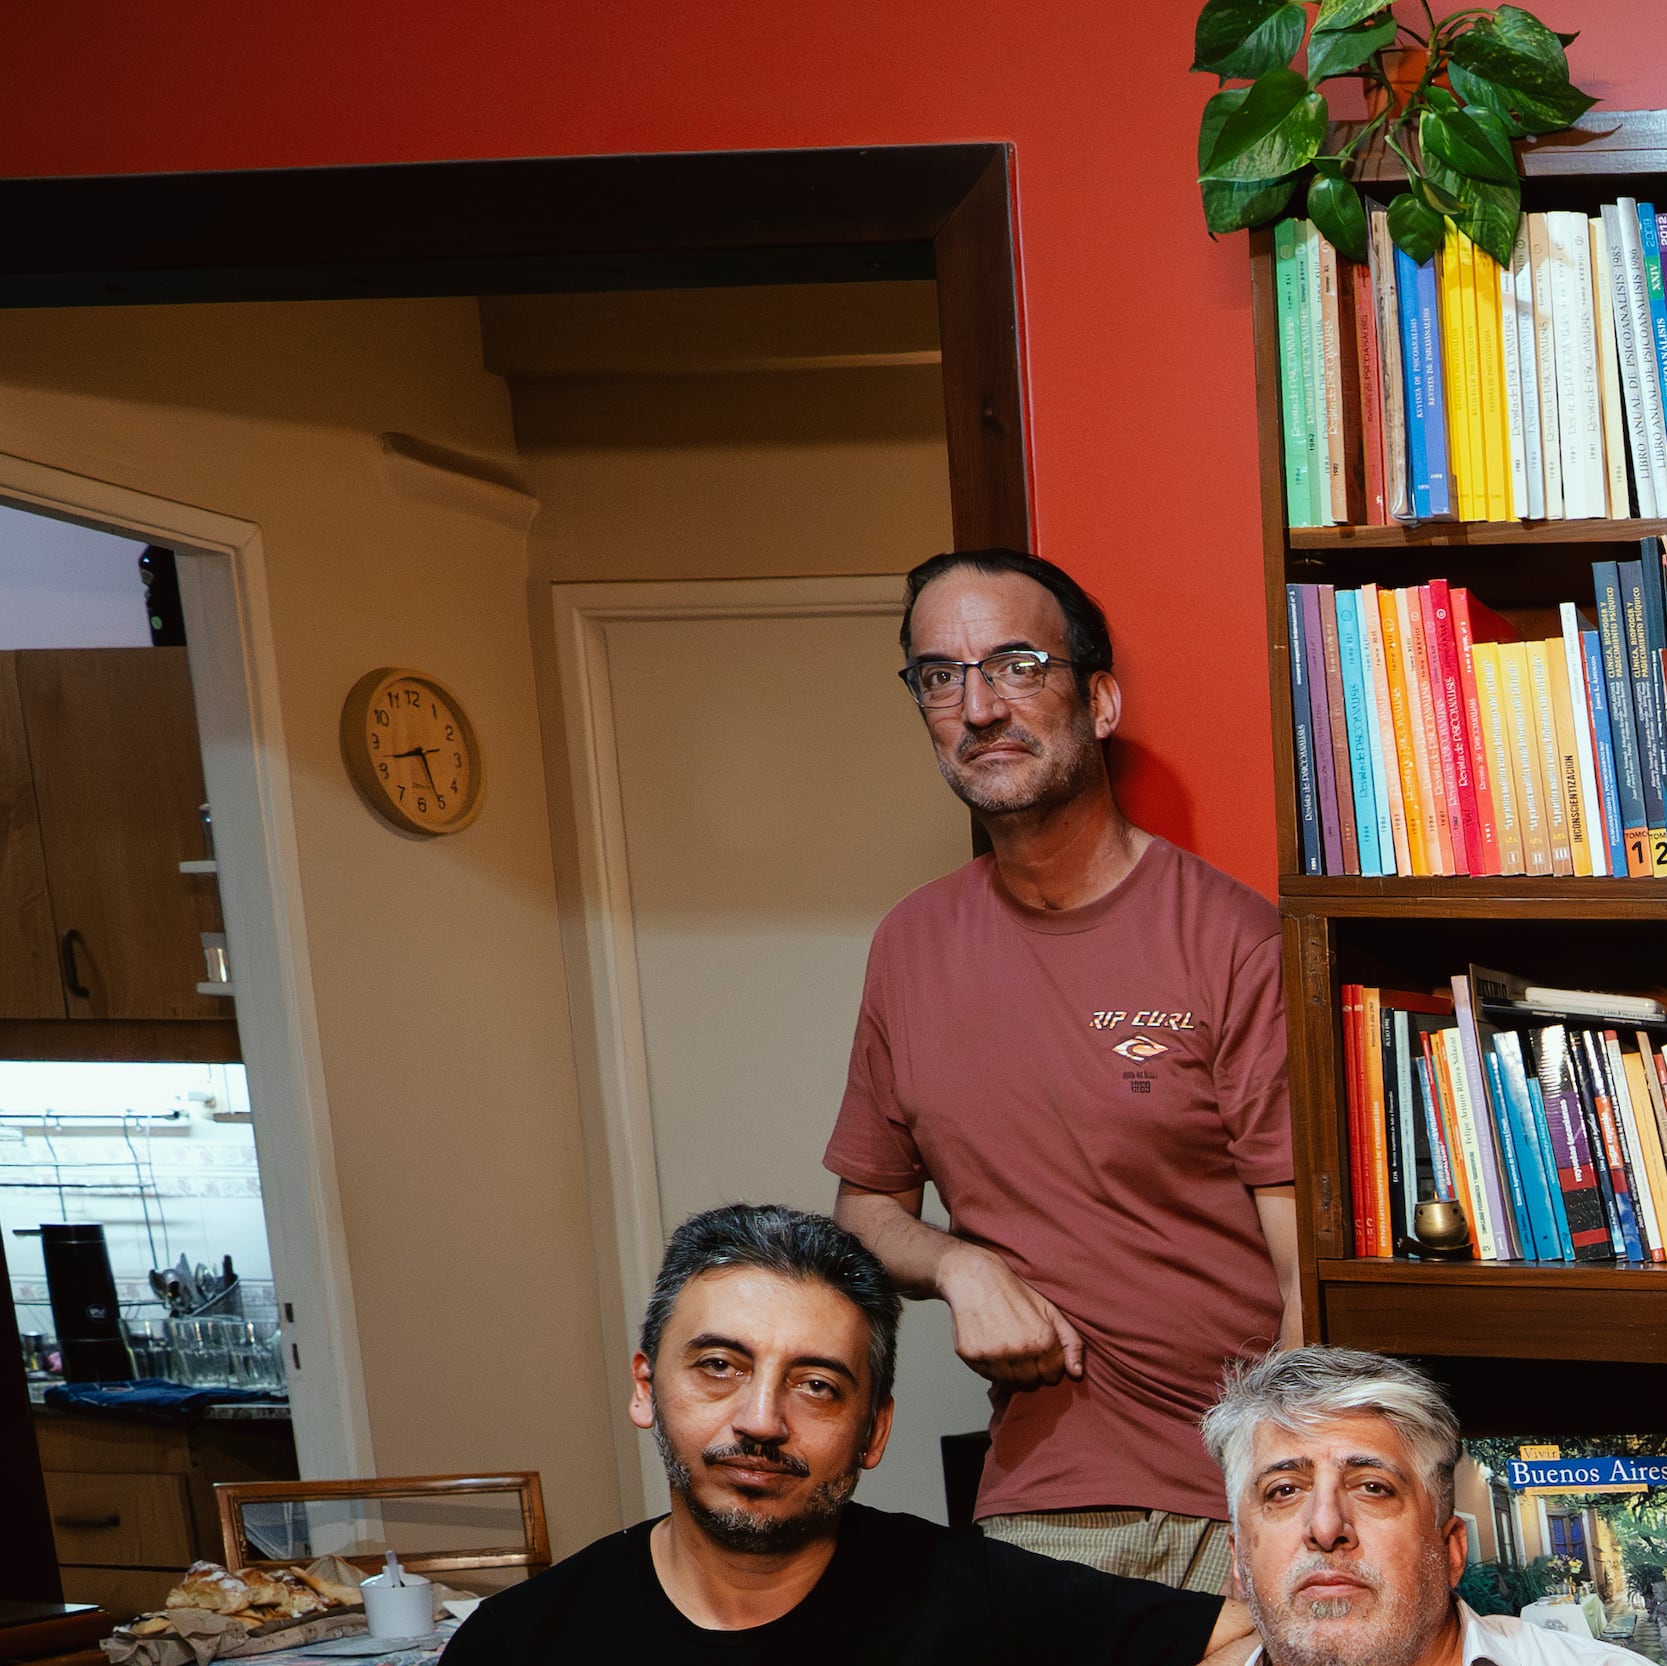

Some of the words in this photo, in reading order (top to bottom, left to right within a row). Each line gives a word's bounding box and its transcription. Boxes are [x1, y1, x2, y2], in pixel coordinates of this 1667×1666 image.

[1610, 245, 1622, 268] 1985
[1615, 274, 1635, 367] PSICOANALISIS
[1628, 376, 1638, 389] DE
[1631, 395, 1645, 438] ANUAL
[1637, 443, 1650, 479] LIBRO
[1606, 587, 1617, 622] PSÍQUICO
[1600, 609, 1611, 646] BIOPODER
[1611, 623, 1623, 678] PADECIMIENTO
[387, 692, 399, 708] 11
[404, 690, 421, 708] 12
[373, 709, 390, 727] 10
[431, 703, 438, 720] 1
[445, 725, 454, 742] 2
[453, 752, 462, 768] 3
[397, 785, 405, 802] 7
[1564, 755, 1583, 842] INCONSCIENTIZACION
[1632, 841, 1644, 864] 1
[1089, 1011, 1128, 1030] RIP
[1132, 1011, 1195, 1031] CURL
[1523, 1448, 1557, 1459] Vivir
[1511, 1461, 1599, 1484] Buenos
